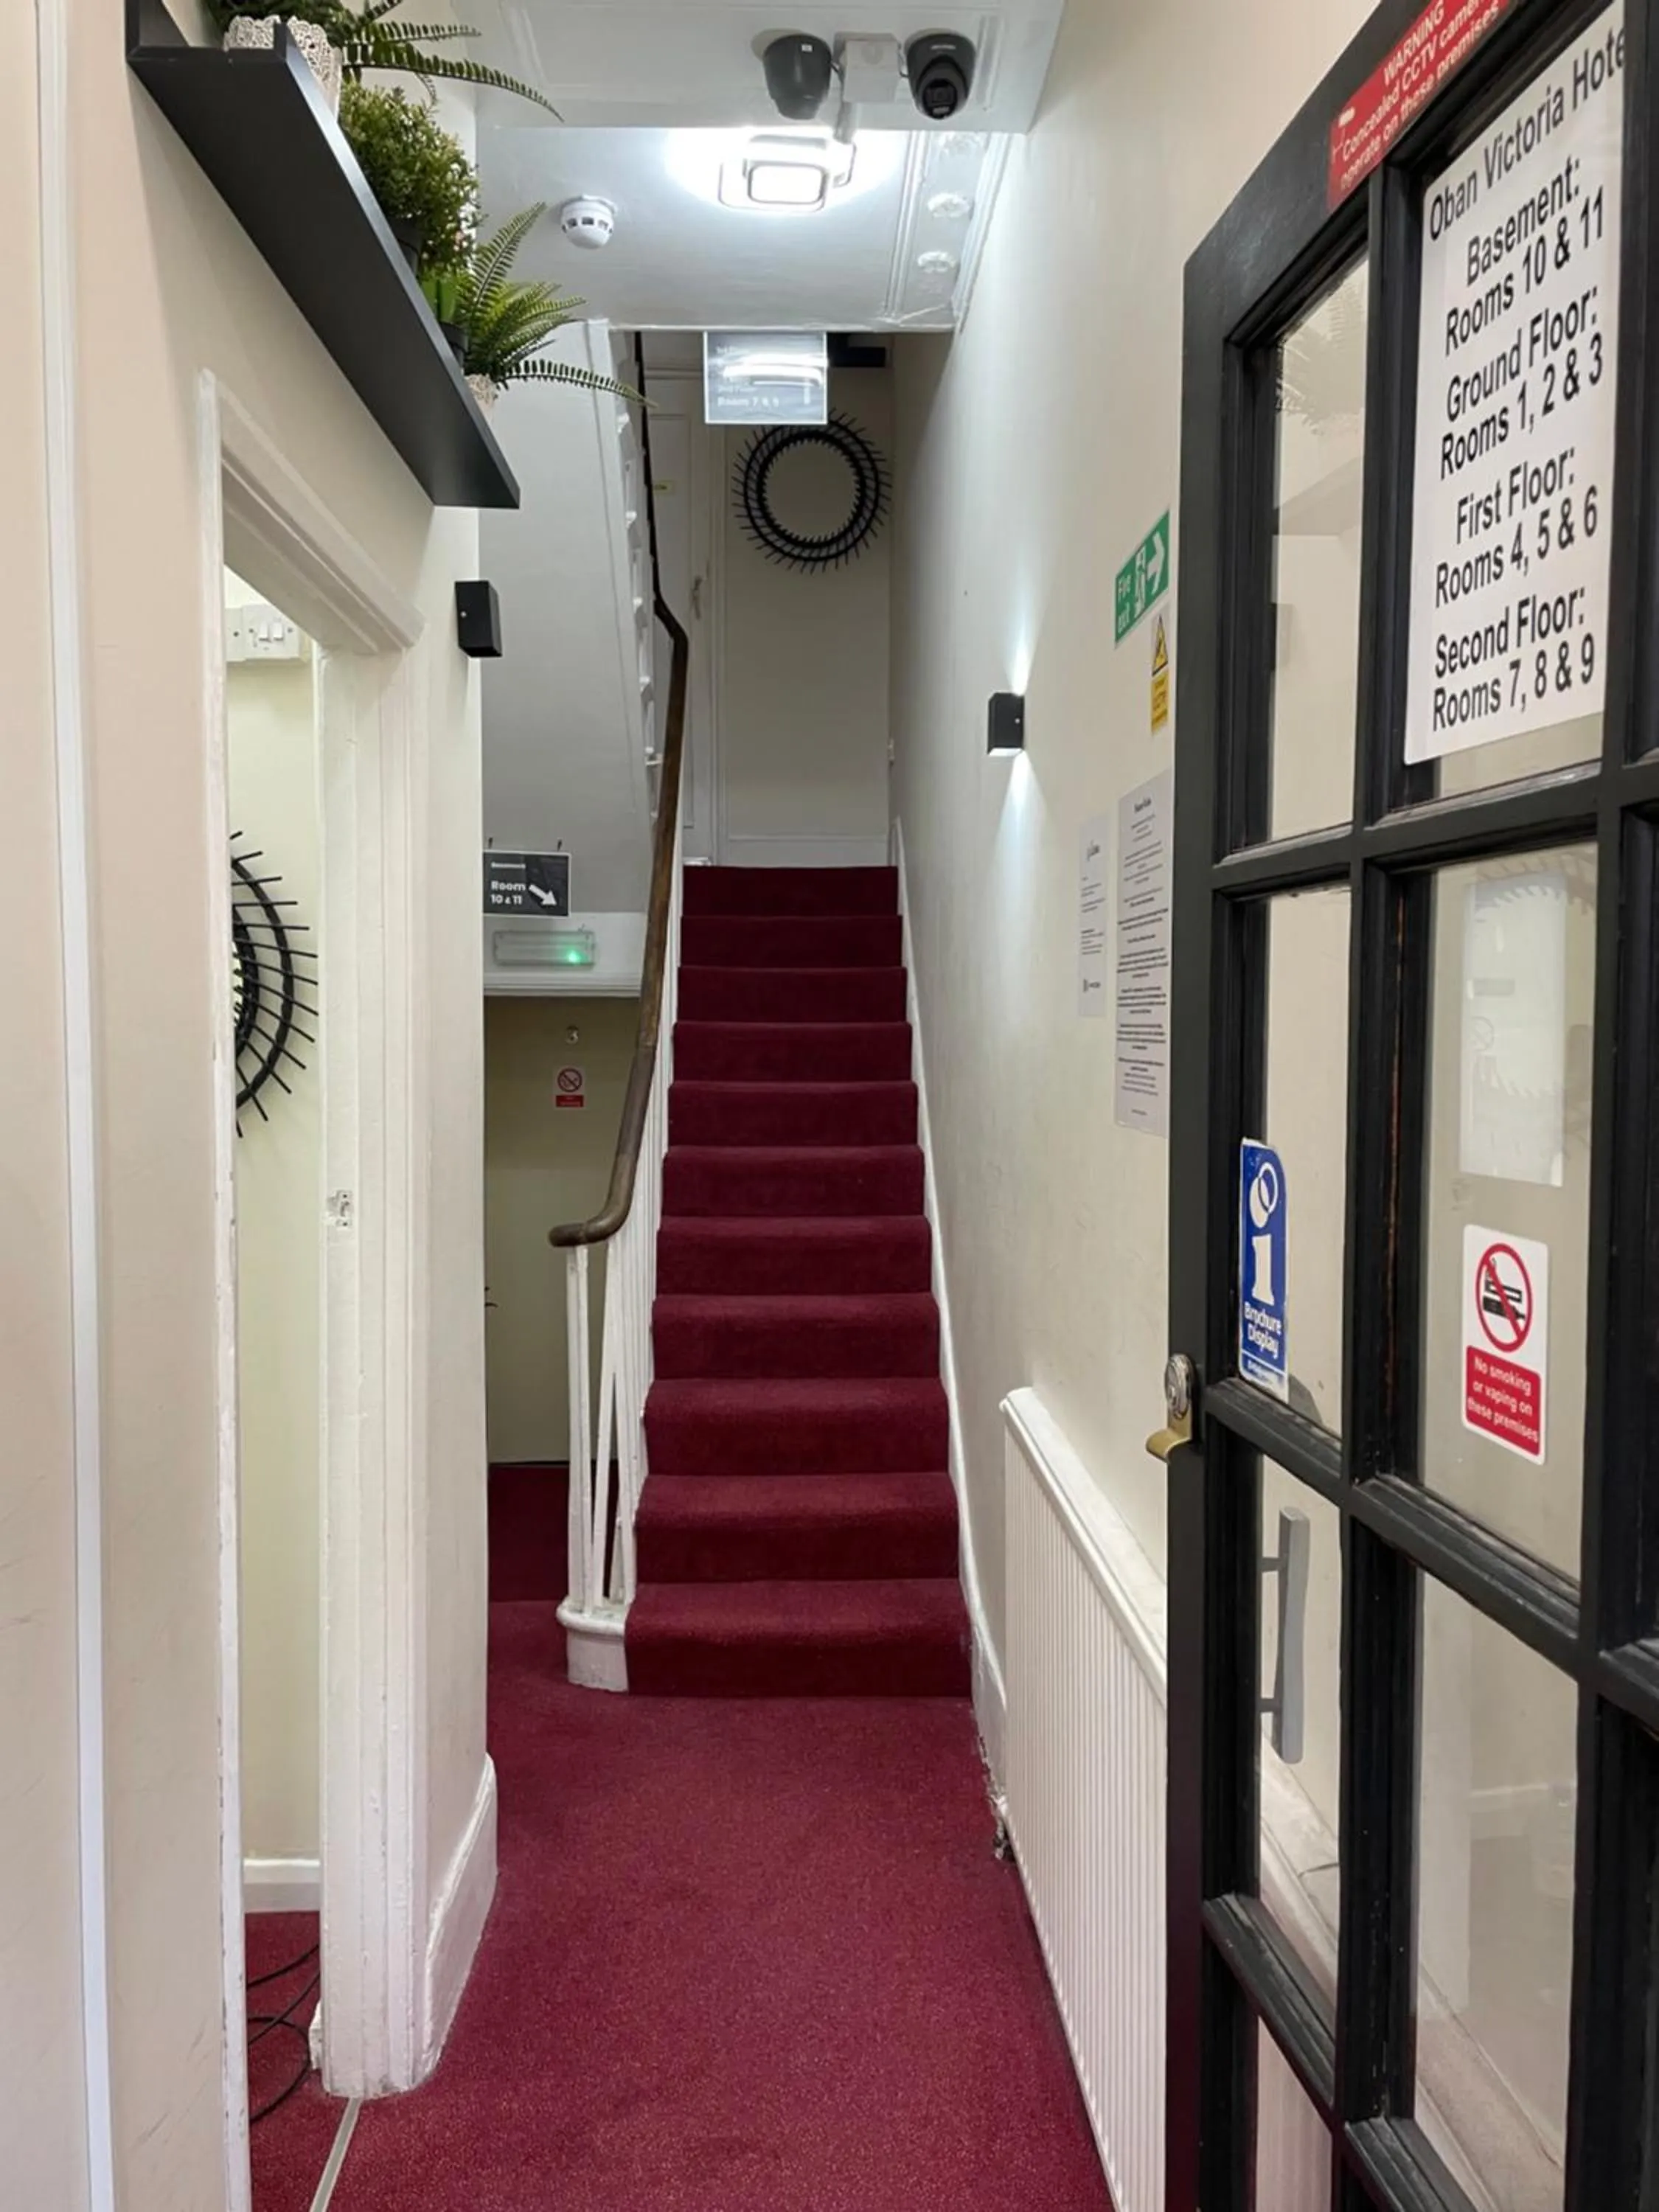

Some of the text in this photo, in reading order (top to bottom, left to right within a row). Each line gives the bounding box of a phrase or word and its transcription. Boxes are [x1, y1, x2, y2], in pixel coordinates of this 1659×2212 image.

[1382, 114, 1399, 142] on
[1401, 73, 1435, 122] these
[1436, 0, 1500, 80] premises
[1383, 0, 1444, 86] WARNING
[1343, 79, 1401, 162] Concealed
[1402, 35, 1438, 91] CCTV
[1430, 27, 1624, 241] Oban Victoria Hote
[1445, 185, 1603, 357] Rooms 10 & 11
[1467, 156, 1580, 288] Basement:
[1447, 285, 1598, 422] Ground Floor:
[1440, 332, 1602, 480] Rooms 1, 2 & 3
[1455, 447, 1575, 545] First Floor:
[1435, 484, 1598, 609] Rooms 4, 5 & 6
[1434, 586, 1585, 679] Second Floor:
[1433, 632, 1595, 732] Rooms 7, 8 & 9
[491, 880, 526, 891] Room
[491, 894, 503, 905] 10
[512, 894, 522, 905] 11
[1244, 1301, 1281, 1335] Brochure
[1248, 1323, 1279, 1360] Display
[1468, 1397, 1538, 1443] these premises
[1473, 1380, 1532, 1416] or vaping on
[1475, 1356, 1531, 1397] No smoking
